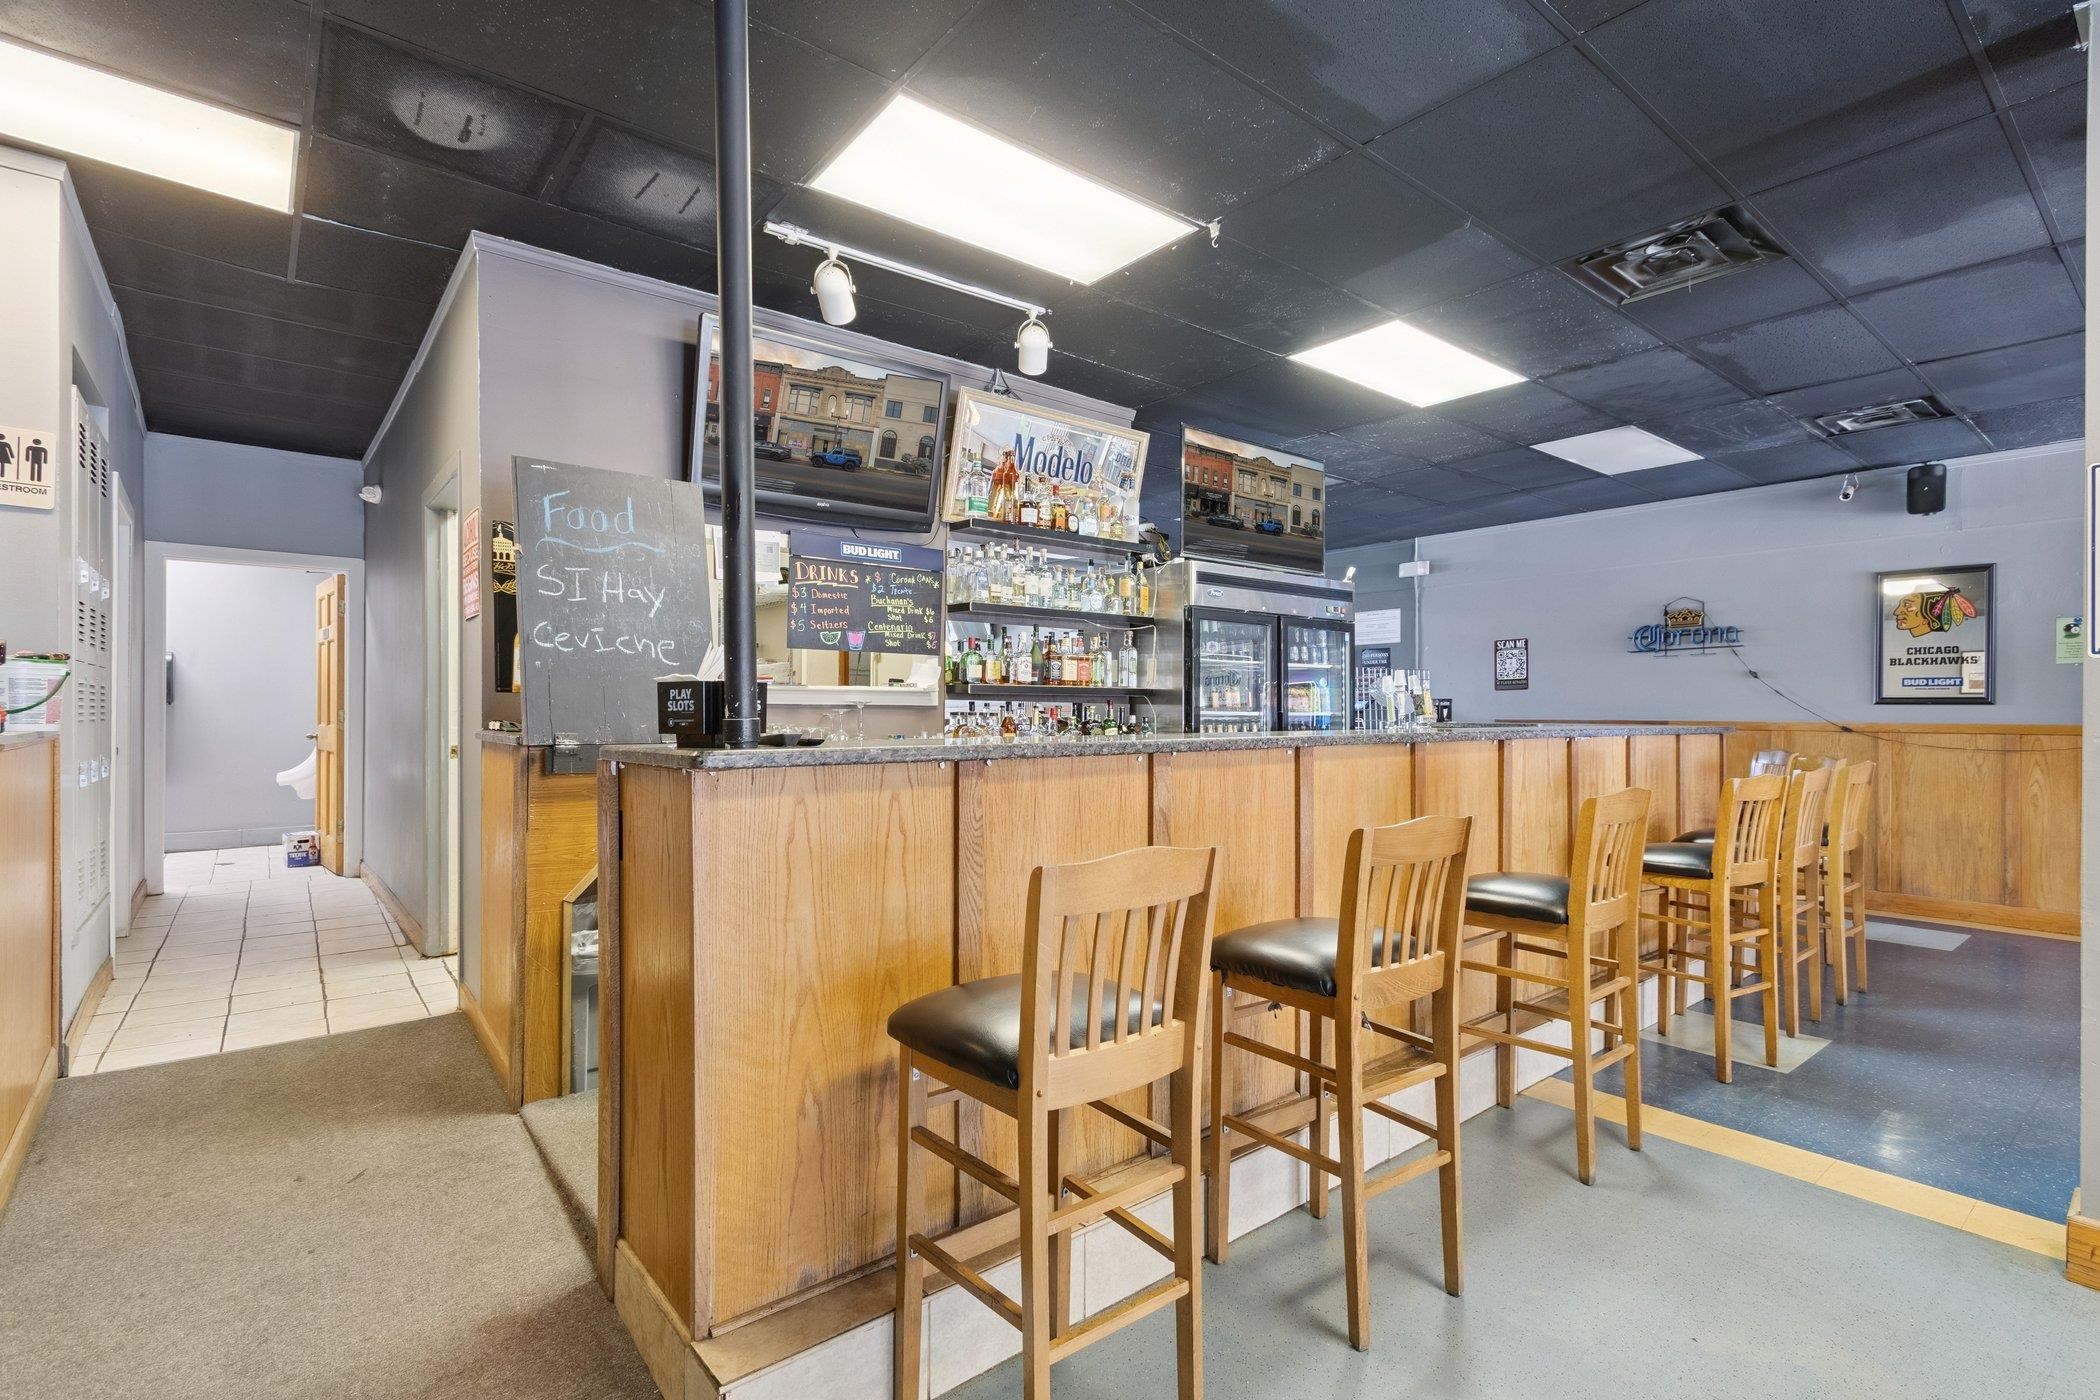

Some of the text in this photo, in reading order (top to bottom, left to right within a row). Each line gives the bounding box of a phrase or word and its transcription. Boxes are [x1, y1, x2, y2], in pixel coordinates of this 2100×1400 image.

[1014, 432, 1093, 485] Modelo
[0, 483, 48, 495] STROOM
[541, 489, 636, 535] Food
[842, 544, 900, 560] BUD LIGHT
[794, 561, 859, 583] DRINKS
[601, 570, 666, 618] Hay
[811, 588, 848, 600] Domestic
[810, 603, 850, 616] Imported
[809, 619, 848, 630] Seltzers
[1496, 639, 1526, 649] SCAN ME
[1632, 623, 1740, 653] Corona
[1906, 645, 1960, 655] CHICAGO
[1889, 655, 1979, 666] BLACKHAWKS
[1903, 678, 1962, 686] BUD LIGHT
[669, 688, 692, 700] PLAY
[667, 699, 695, 711] SLOTS
